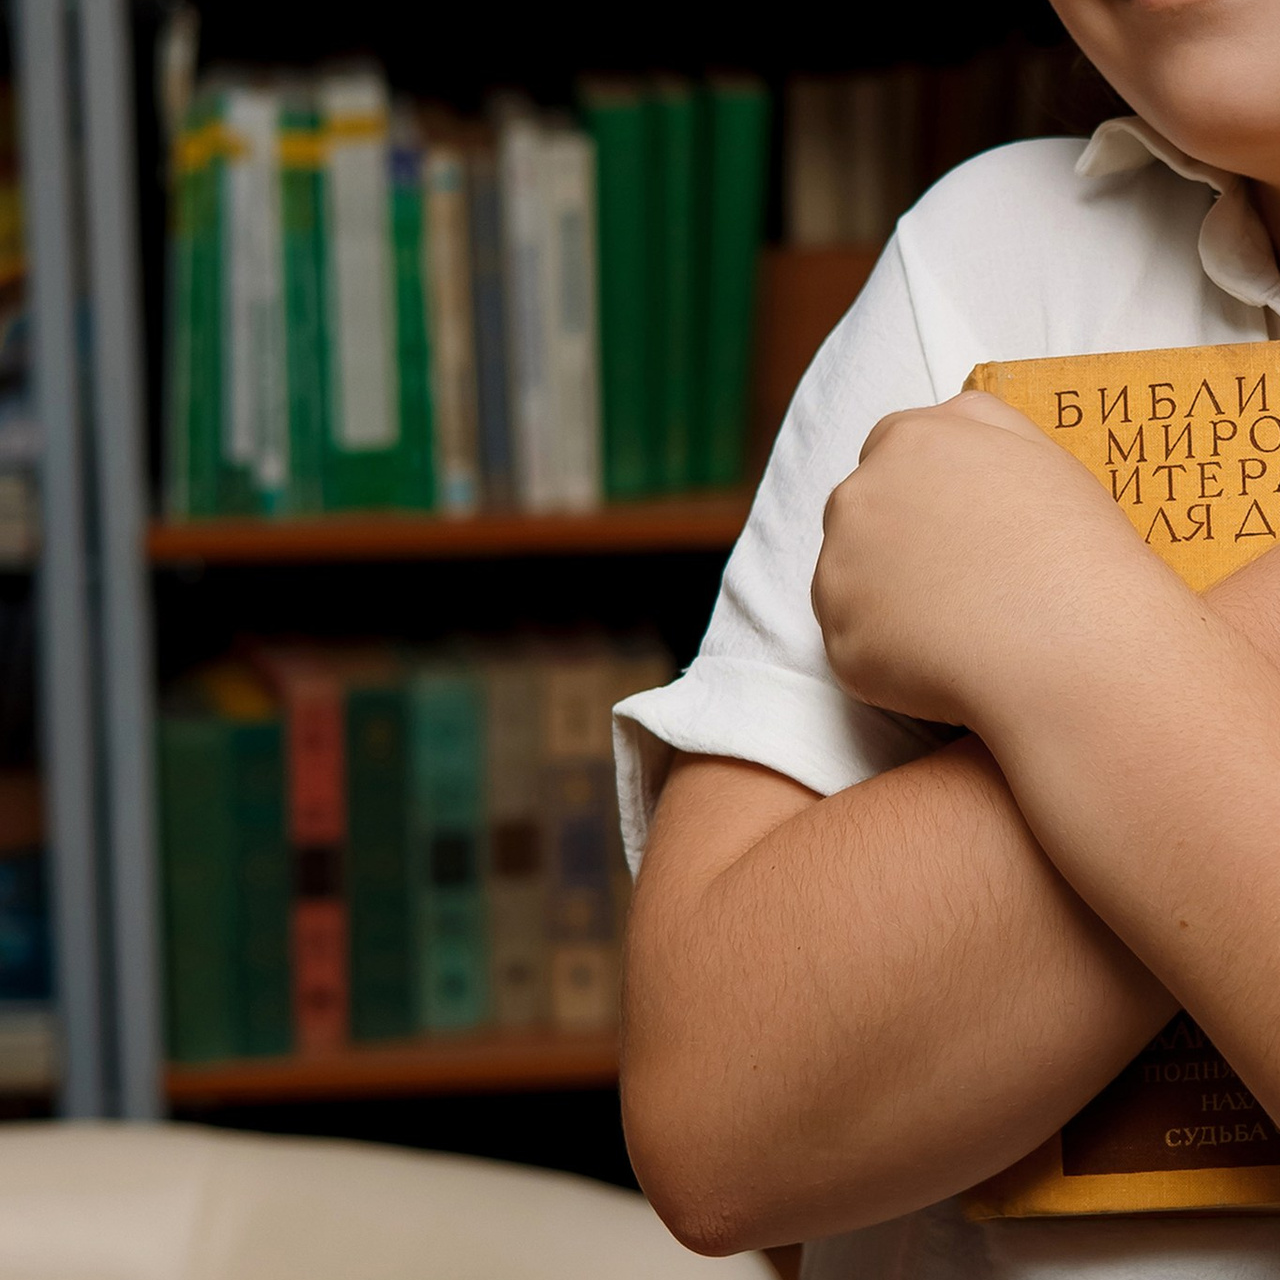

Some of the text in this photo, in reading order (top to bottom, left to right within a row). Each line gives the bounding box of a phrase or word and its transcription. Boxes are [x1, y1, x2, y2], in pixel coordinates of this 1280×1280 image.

[1144, 503, 1215, 545] ЛЯ
[1143, 1061, 1236, 1082] ПОДНЯ
[1201, 1092, 1257, 1112] НАХ
[1165, 1123, 1267, 1148] СУДЬБА
